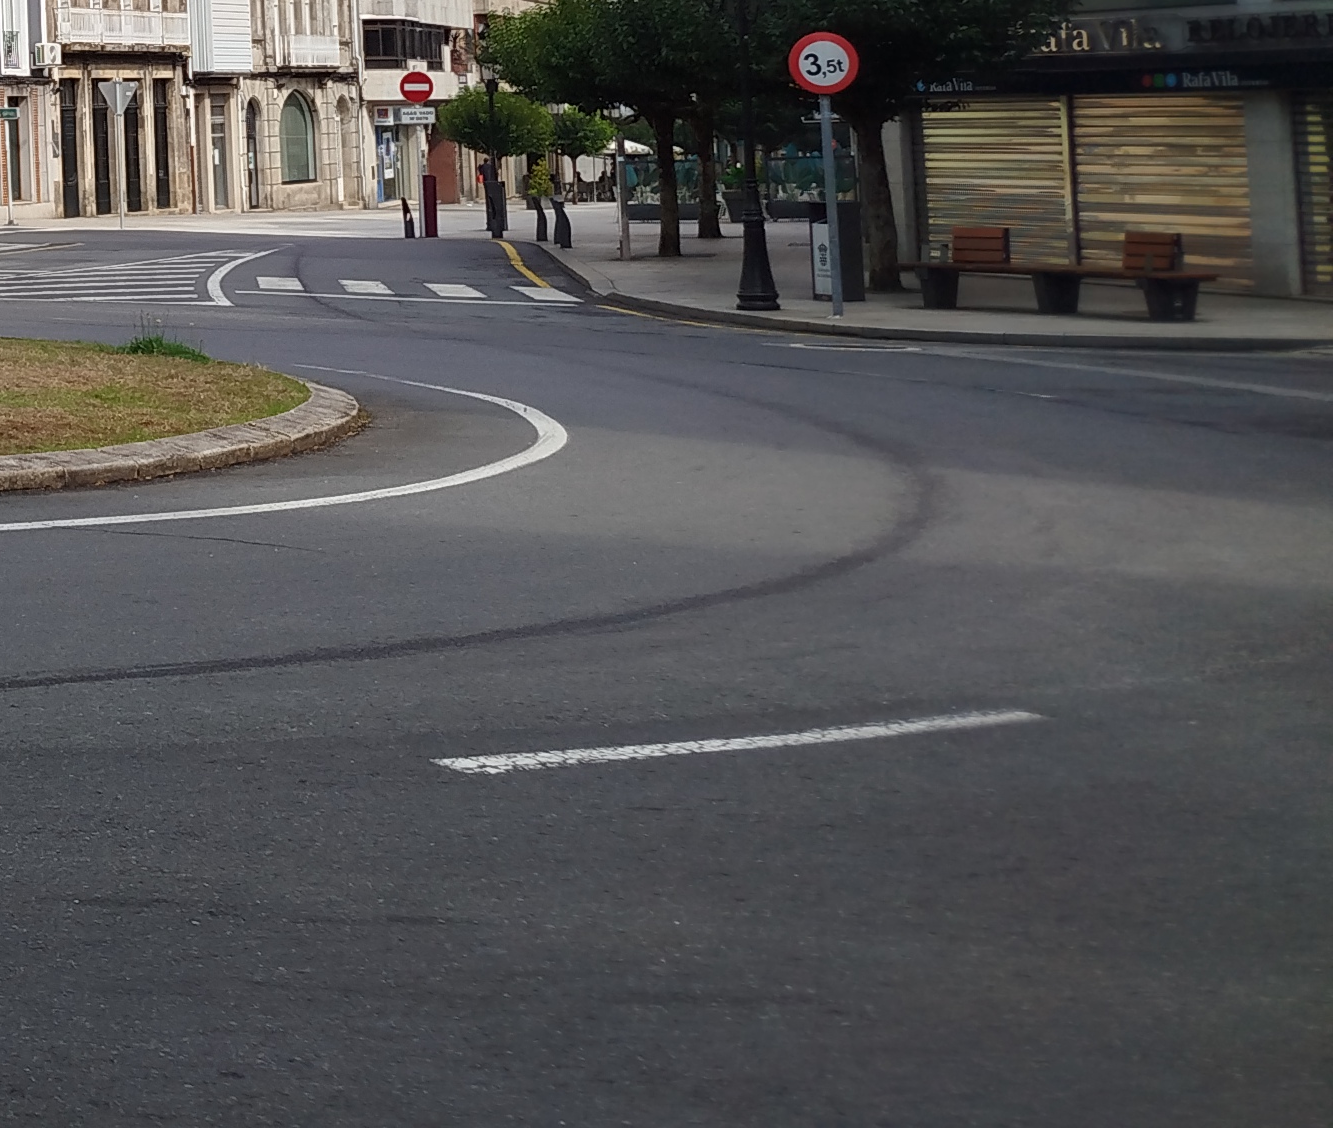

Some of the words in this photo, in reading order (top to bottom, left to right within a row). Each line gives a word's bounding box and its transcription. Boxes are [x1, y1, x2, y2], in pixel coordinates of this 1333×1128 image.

[803, 53, 845, 78] 3,5t
[1182, 72, 1211, 88] Rafa
[1211, 70, 1239, 86] Vila
